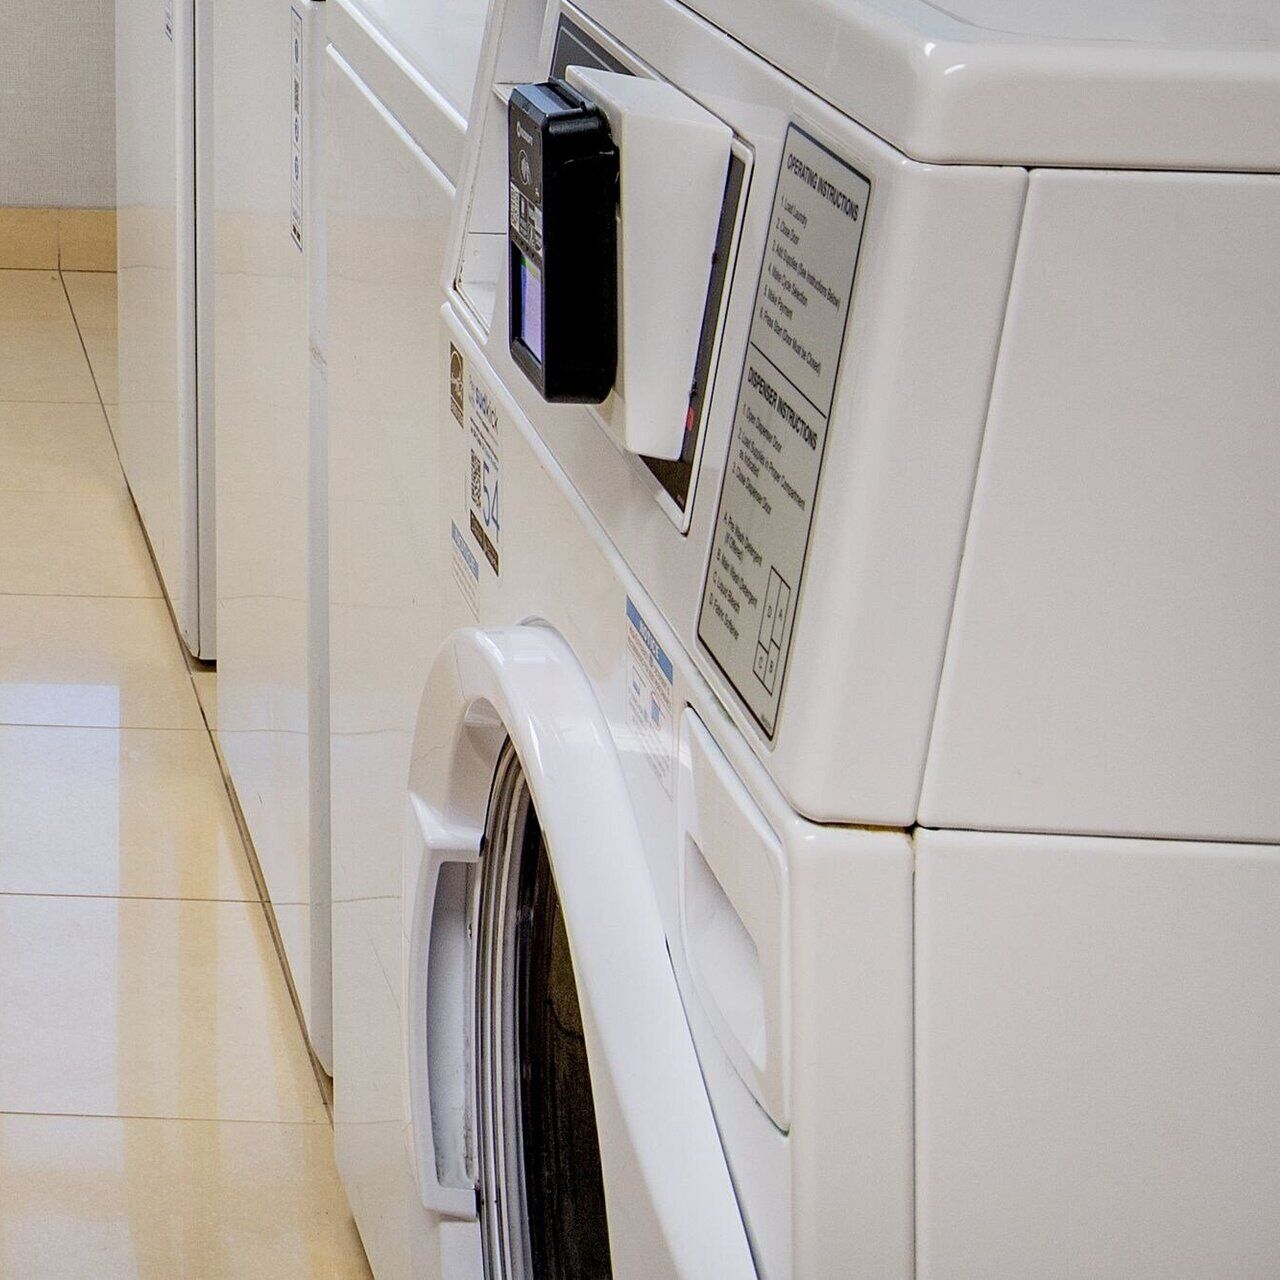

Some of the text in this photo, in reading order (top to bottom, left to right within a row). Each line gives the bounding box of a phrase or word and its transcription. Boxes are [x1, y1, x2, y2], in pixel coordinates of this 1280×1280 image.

[786, 152, 859, 222] OPERATING INSTRUCTIONS
[747, 365, 818, 452] DISPENSER INSTRUCTIONS
[483, 460, 500, 544] 54
